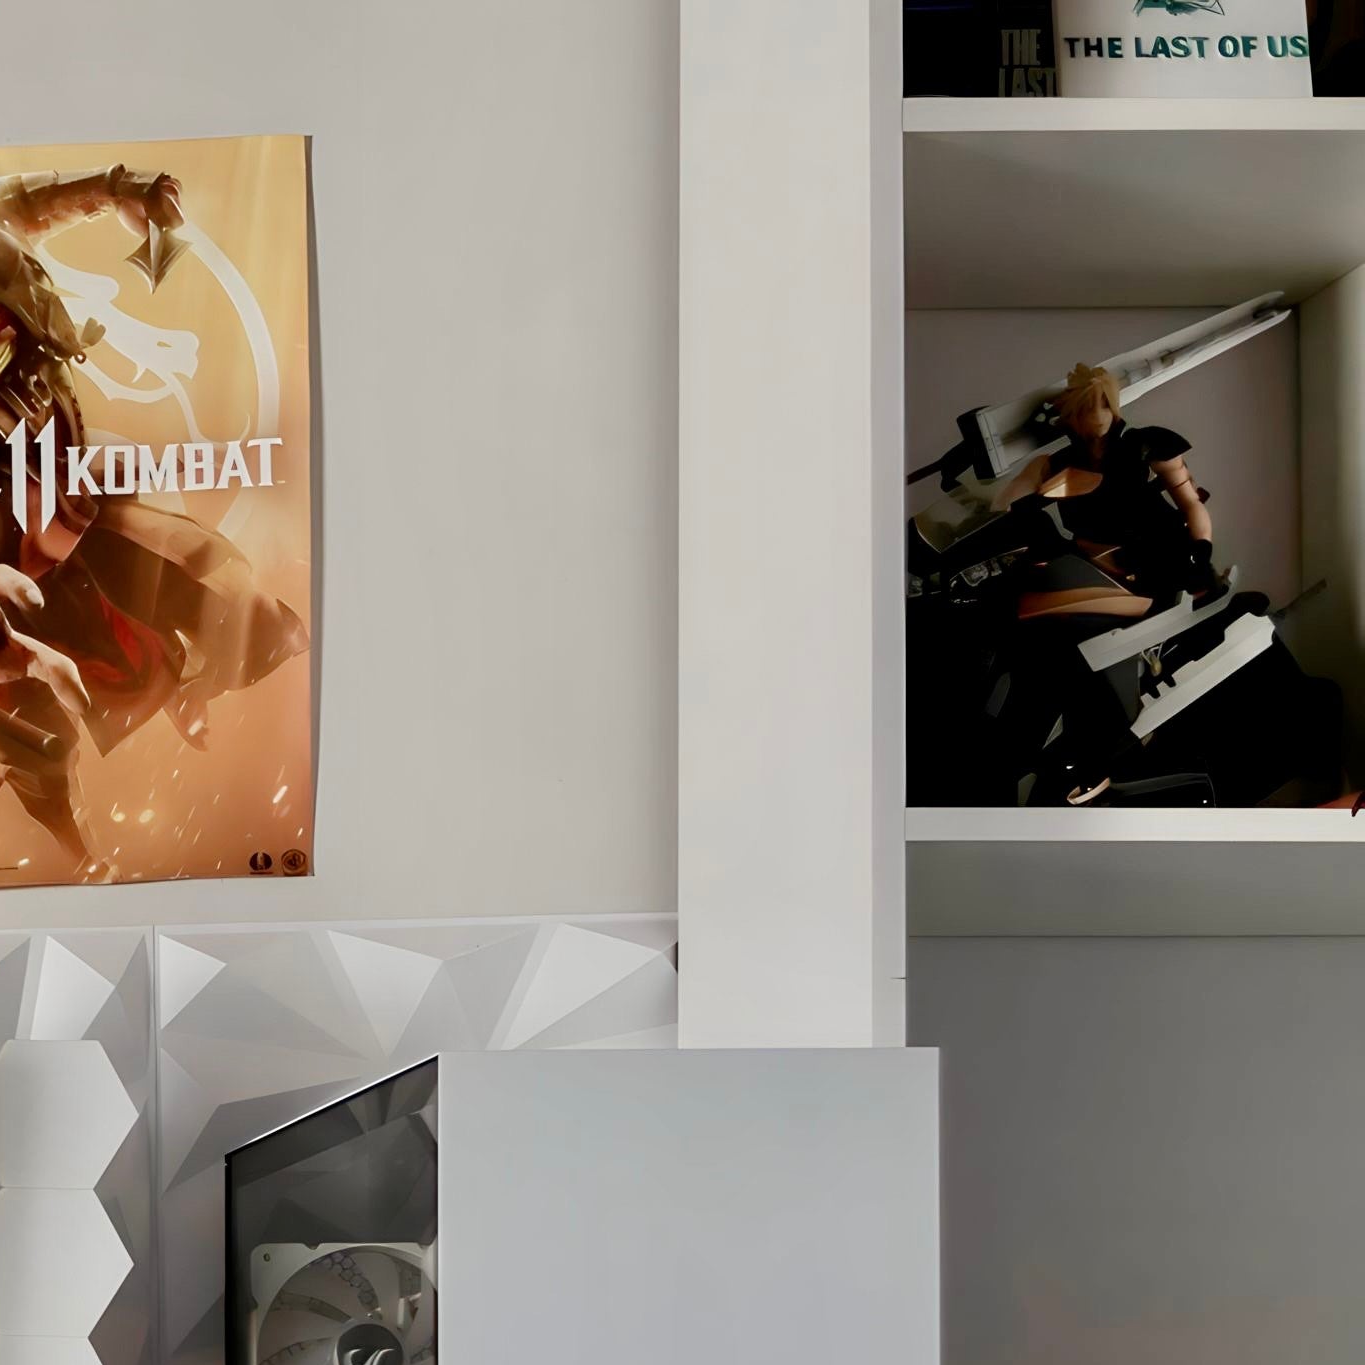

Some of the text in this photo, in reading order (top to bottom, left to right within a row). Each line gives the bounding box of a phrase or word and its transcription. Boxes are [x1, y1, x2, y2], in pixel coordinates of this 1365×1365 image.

[1001, 29, 1041, 66] THE
[1064, 35, 1309, 59] THE LAST OF US
[65, 437, 283, 497] KOMBAT
